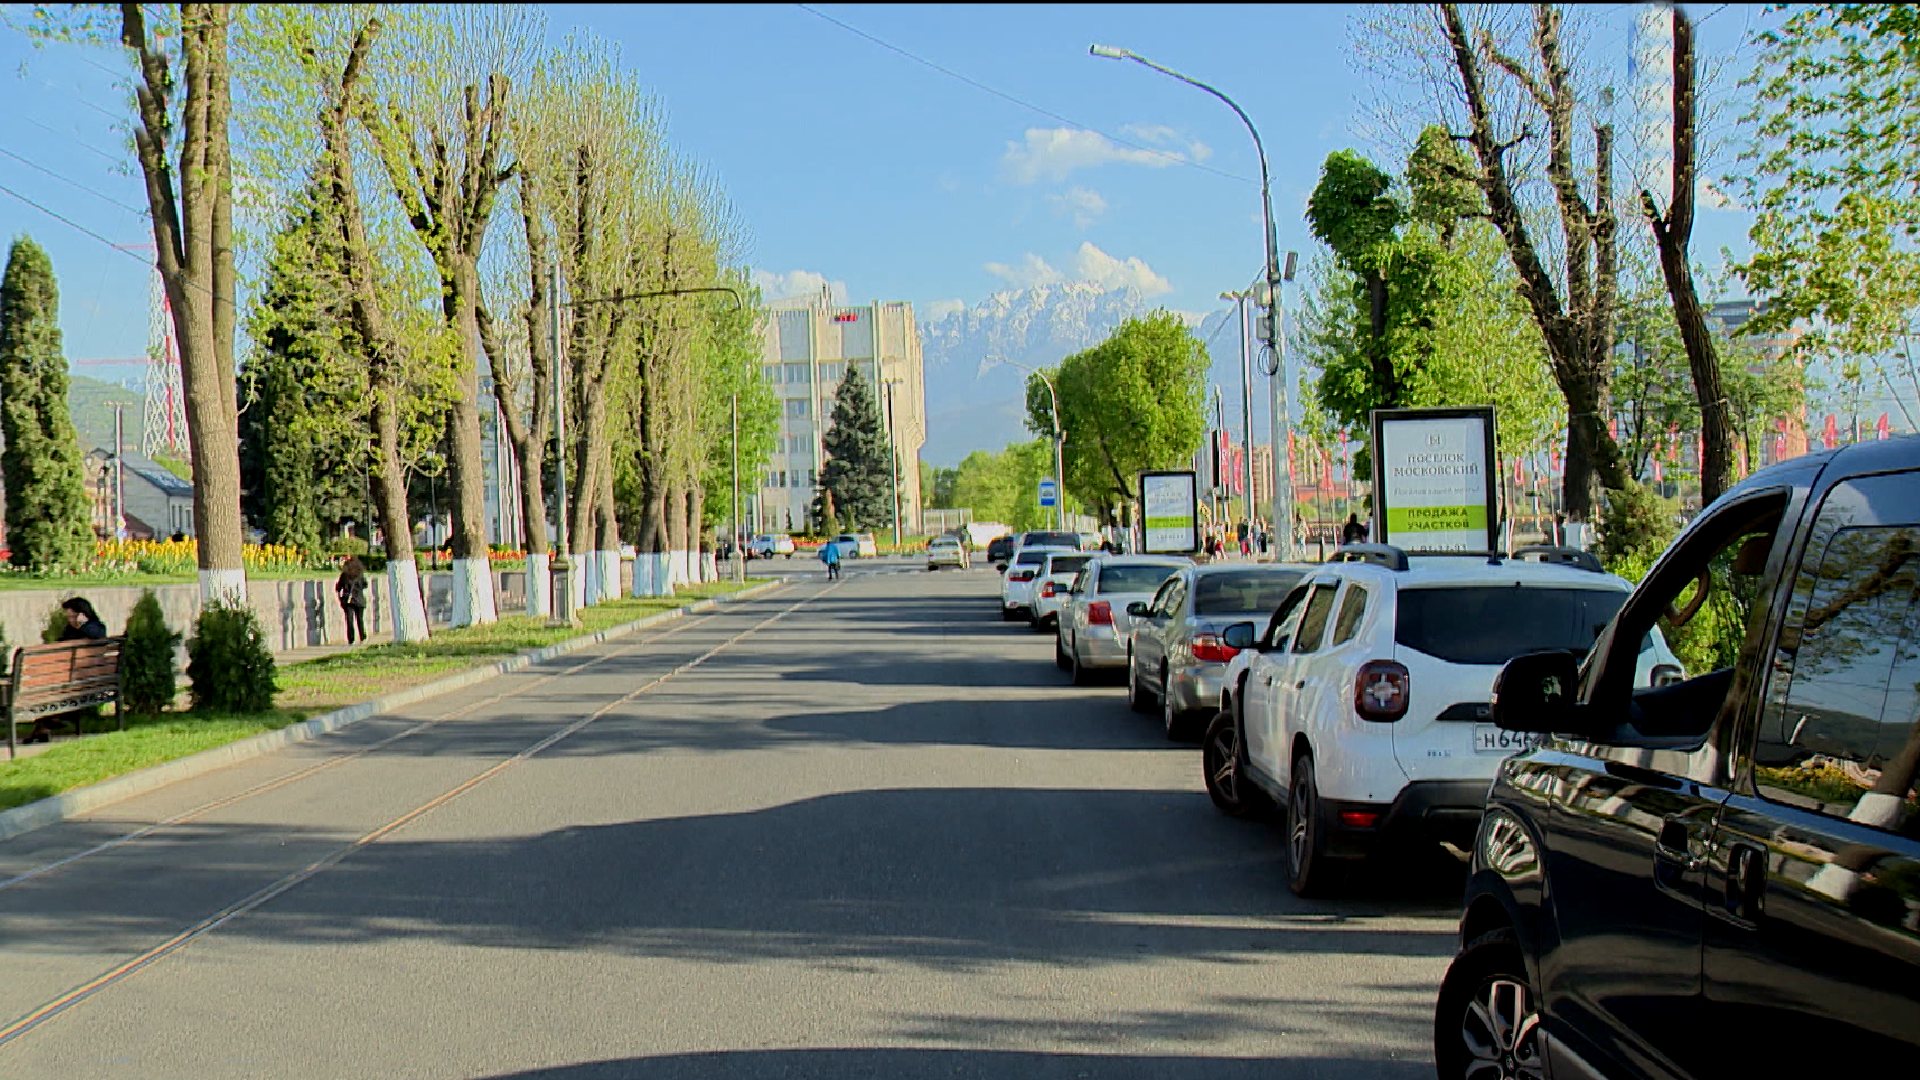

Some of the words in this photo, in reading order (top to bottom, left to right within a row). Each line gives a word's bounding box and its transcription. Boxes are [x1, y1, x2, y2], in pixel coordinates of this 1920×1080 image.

[1393, 461, 1479, 477] МОСКОВСКИЙ
[1407, 507, 1469, 519] ПРОДАЖА
[1407, 519, 1470, 530] УЧАСТКОВ
